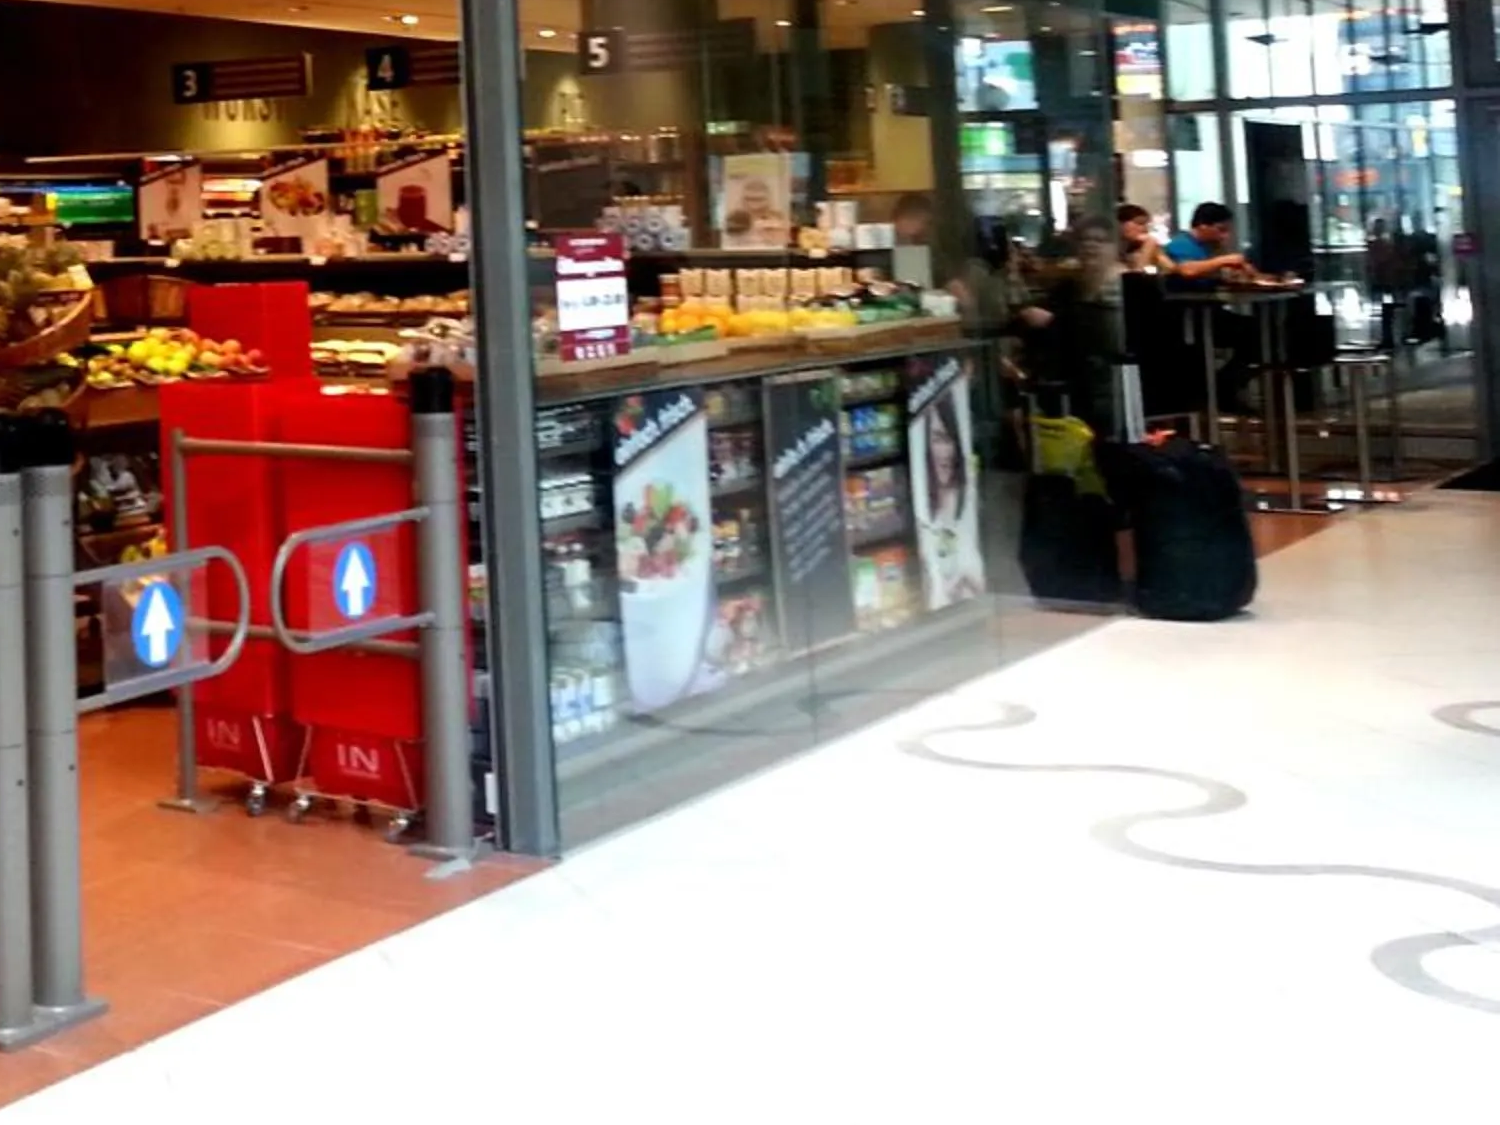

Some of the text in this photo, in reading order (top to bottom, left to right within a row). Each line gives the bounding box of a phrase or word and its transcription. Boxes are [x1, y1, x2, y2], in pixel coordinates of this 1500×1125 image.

[587, 36, 610, 68] 5
[376, 53, 394, 82] 4
[182, 69, 198, 97] 3
[206, 717, 241, 746] IN
[336, 743, 380, 773] IN
